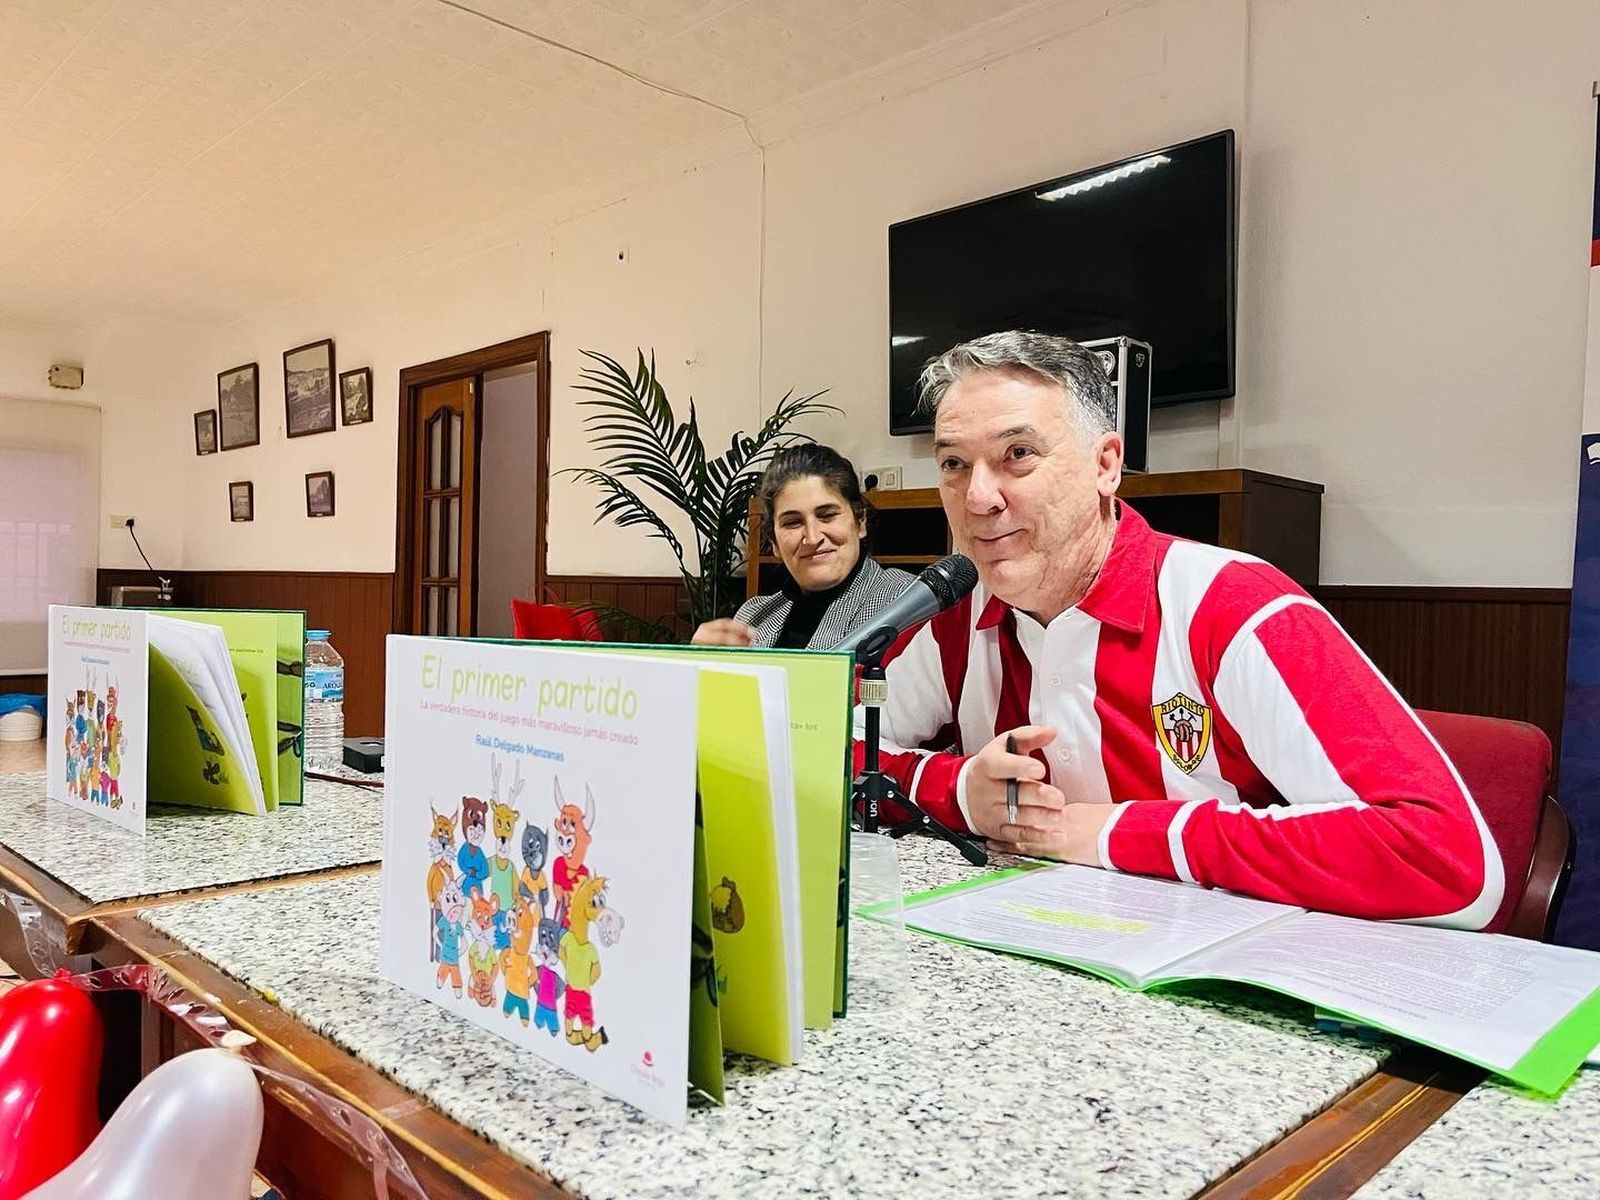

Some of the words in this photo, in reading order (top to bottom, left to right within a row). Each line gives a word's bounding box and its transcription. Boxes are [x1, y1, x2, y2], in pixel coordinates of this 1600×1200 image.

[71, 618, 97, 641] primer
[101, 617, 132, 643] partido
[421, 653, 442, 690] El
[451, 663, 527, 703] primer
[537, 675, 639, 720] partido
[1161, 694, 1204, 715] RIOTINTO
[420, 699, 428, 709] La
[429, 702, 460, 714] verdadera
[462, 704, 486, 719] historia
[487, 710, 499, 721] del
[500, 711, 520, 727] juego
[521, 714, 536, 728] más
[538, 718, 583, 736] maravilloso
[583, 724, 608, 740] jamás
[609, 729, 639, 746] creado
[475, 733, 493, 748] Raúl
[493, 736, 526, 753] Delgado
[526, 743, 565, 762] Manzanas
